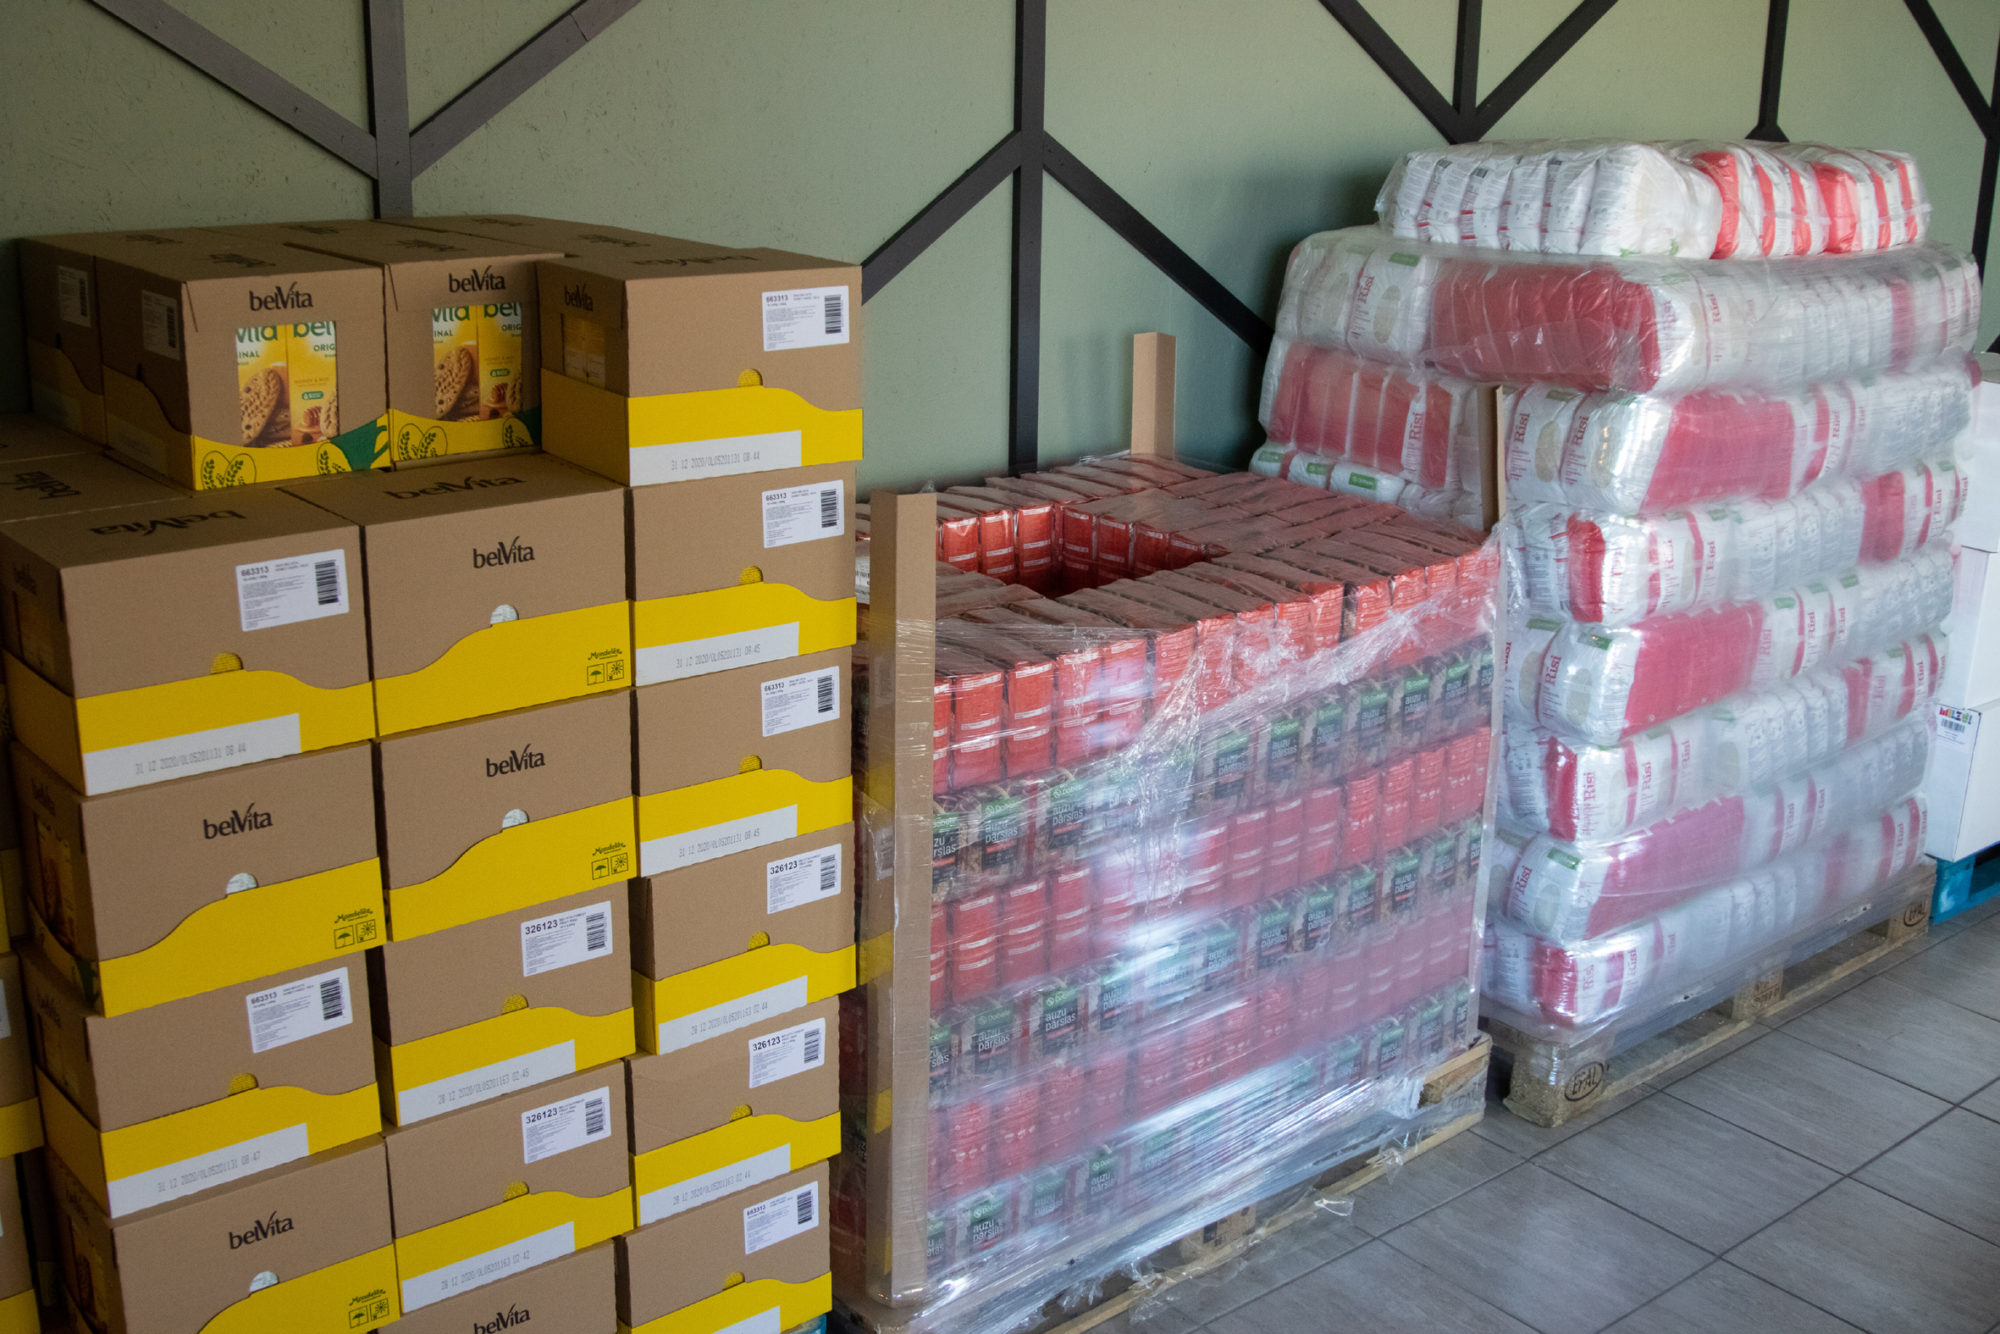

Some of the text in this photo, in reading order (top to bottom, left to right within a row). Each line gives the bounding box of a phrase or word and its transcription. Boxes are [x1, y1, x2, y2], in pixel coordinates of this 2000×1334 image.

[449, 265, 506, 293] belVita
[249, 281, 313, 311] belVita
[384, 476, 526, 500] belVita
[473, 536, 535, 569] belVita
[486, 744, 545, 777] belVita
[203, 802, 273, 839] belVita
[770, 860, 798, 875] 326123
[525, 919, 558, 935] 326123
[752, 1036, 781, 1052] 326123
[525, 1107, 558, 1124] 326123
[229, 1211, 294, 1249] belVita
[474, 1304, 531, 1334] belVita
